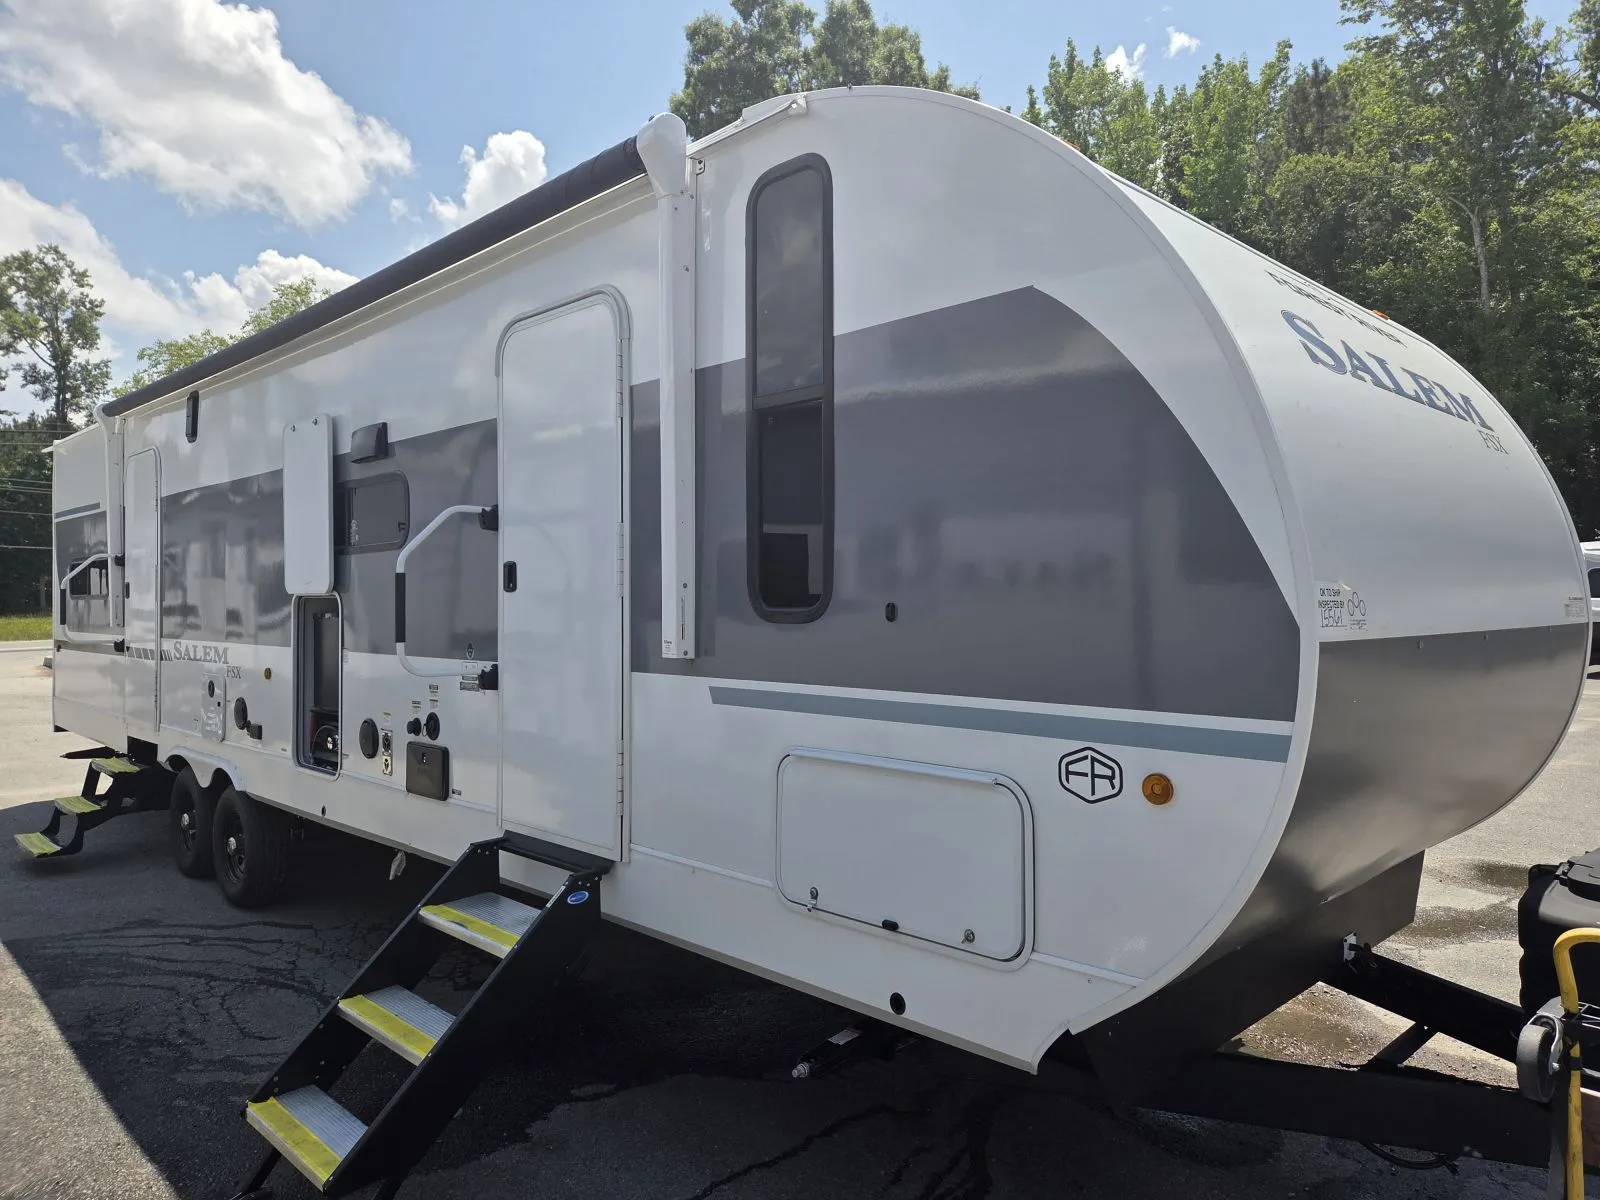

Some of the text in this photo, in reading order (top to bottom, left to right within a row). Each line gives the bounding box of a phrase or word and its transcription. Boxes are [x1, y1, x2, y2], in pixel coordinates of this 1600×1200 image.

[1264, 269, 1352, 320] FOREST
[1280, 309, 1495, 432] SALEM
[1477, 428, 1509, 455] FSX
[1317, 600, 1339, 608] INSPECTED
[1319, 588, 1326, 597] OK
[173, 640, 230, 664] SALEM
[226, 665, 242, 679] FSX
